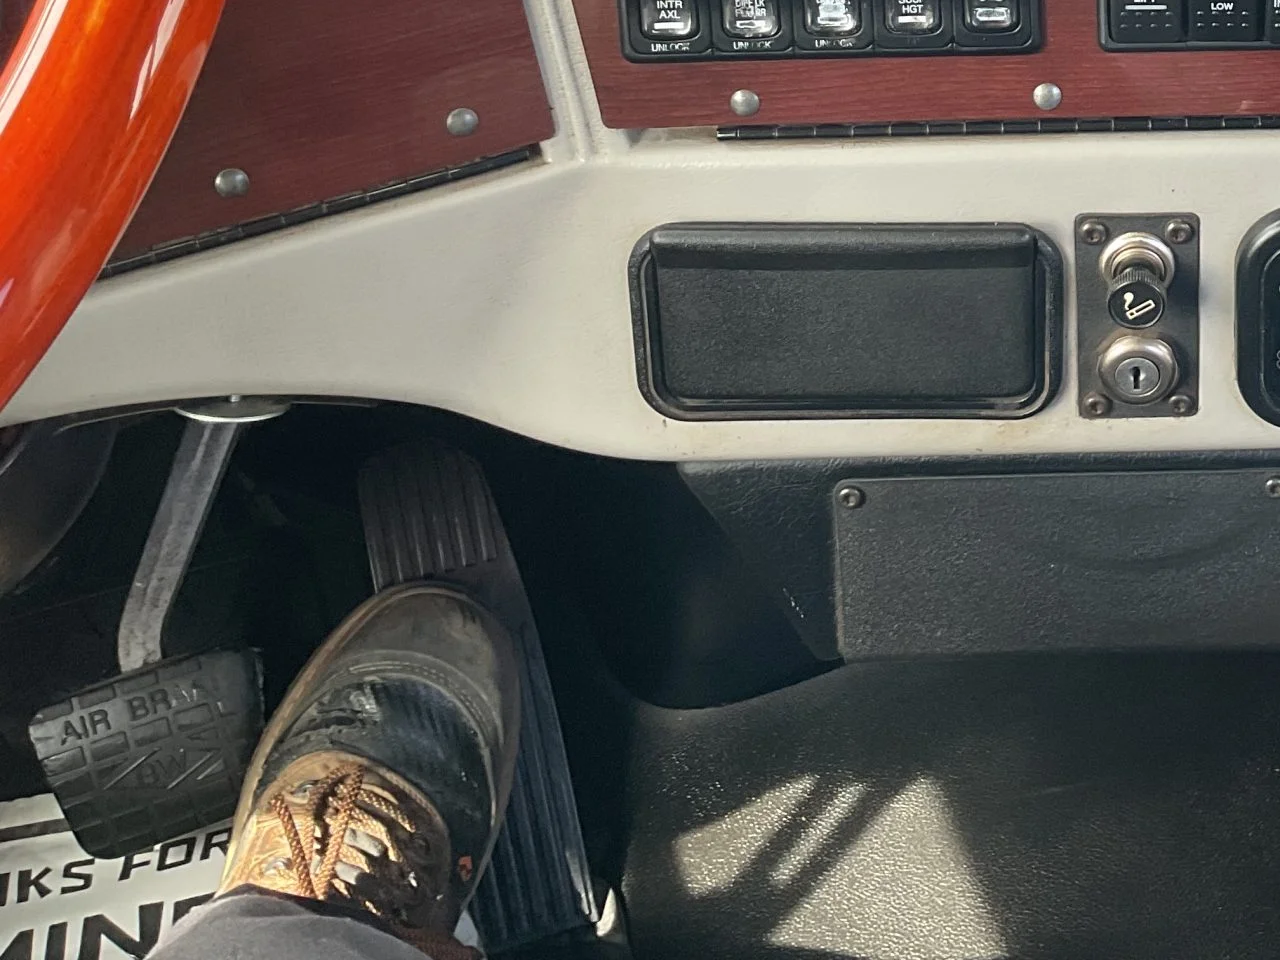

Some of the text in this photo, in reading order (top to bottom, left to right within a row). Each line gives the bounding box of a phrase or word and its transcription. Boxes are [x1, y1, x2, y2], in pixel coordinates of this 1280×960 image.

[656, 0, 683, 9] INTR
[901, 4, 924, 14] HGT
[1210, 2, 1234, 11] LOW
[659, 9, 681, 19] AXL
[732, 40, 773, 51] UNCK
[60, 708, 112, 745] AIR
[117, 827, 231, 881] FOR
